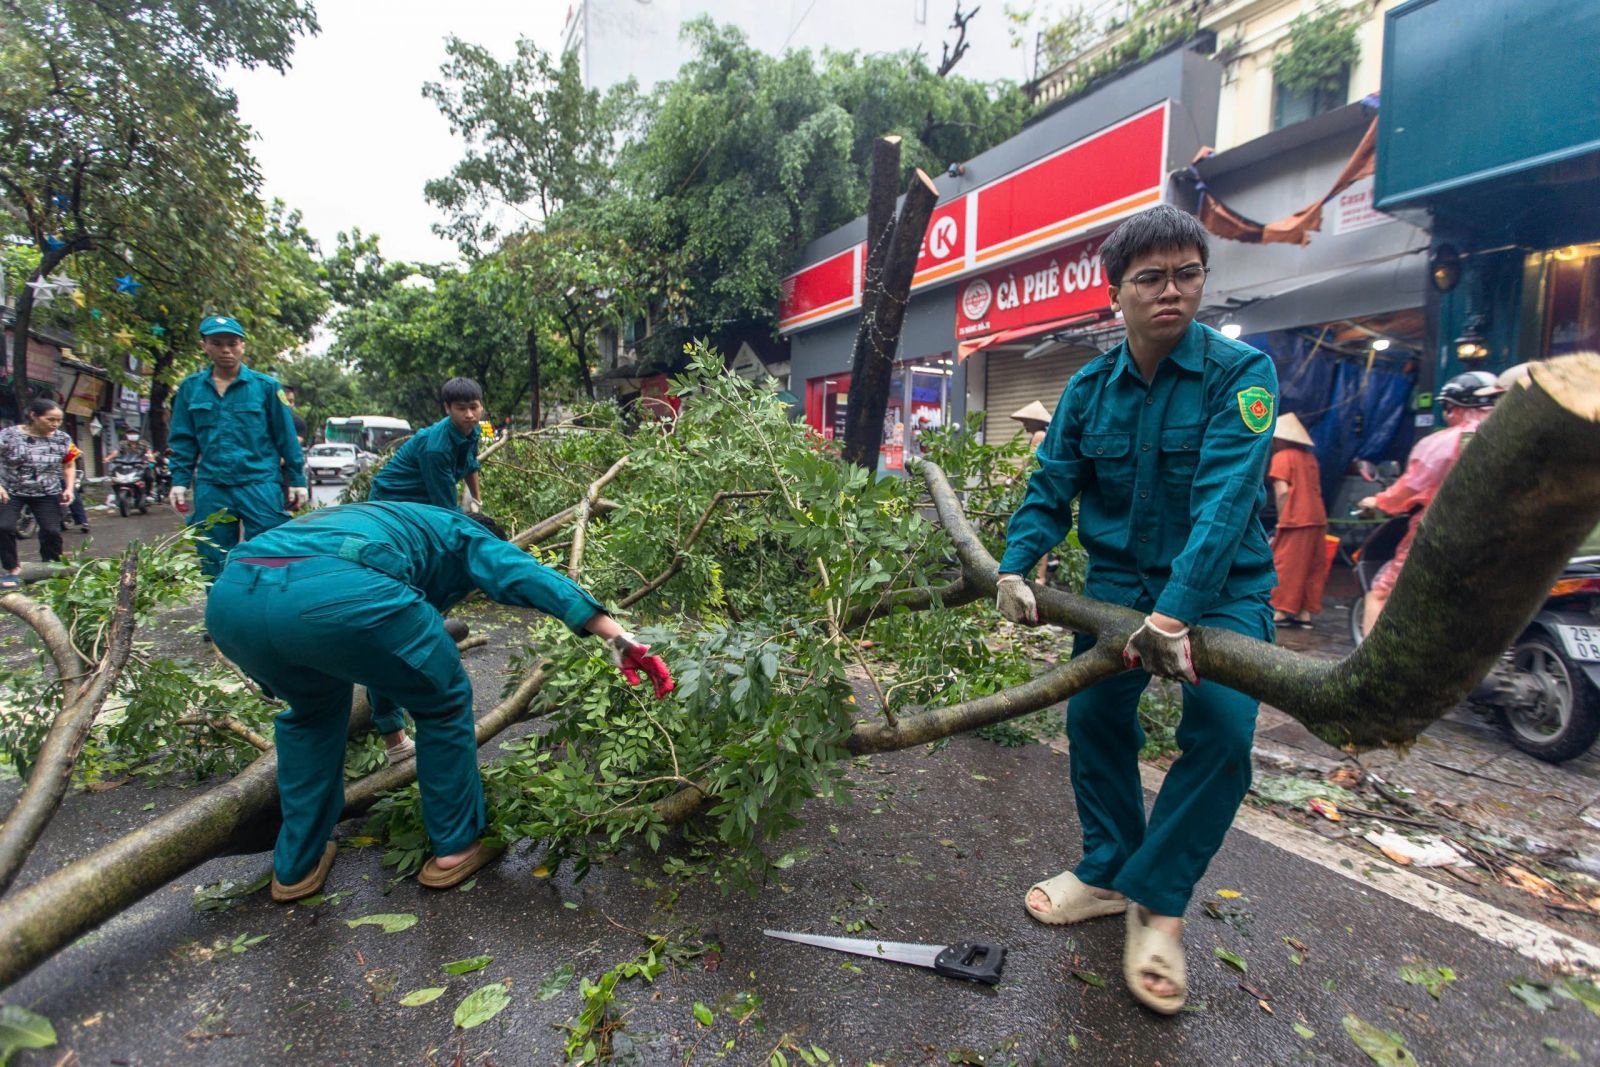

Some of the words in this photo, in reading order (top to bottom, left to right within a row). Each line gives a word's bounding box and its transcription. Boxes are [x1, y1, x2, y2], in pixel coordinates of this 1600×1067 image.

[934, 220, 955, 252] K
[996, 273, 1020, 311] CÀ
[1023, 258, 1060, 305] PHÊ
[1062, 243, 1103, 294] CỐT
[1569, 626, 1600, 641] 29-
